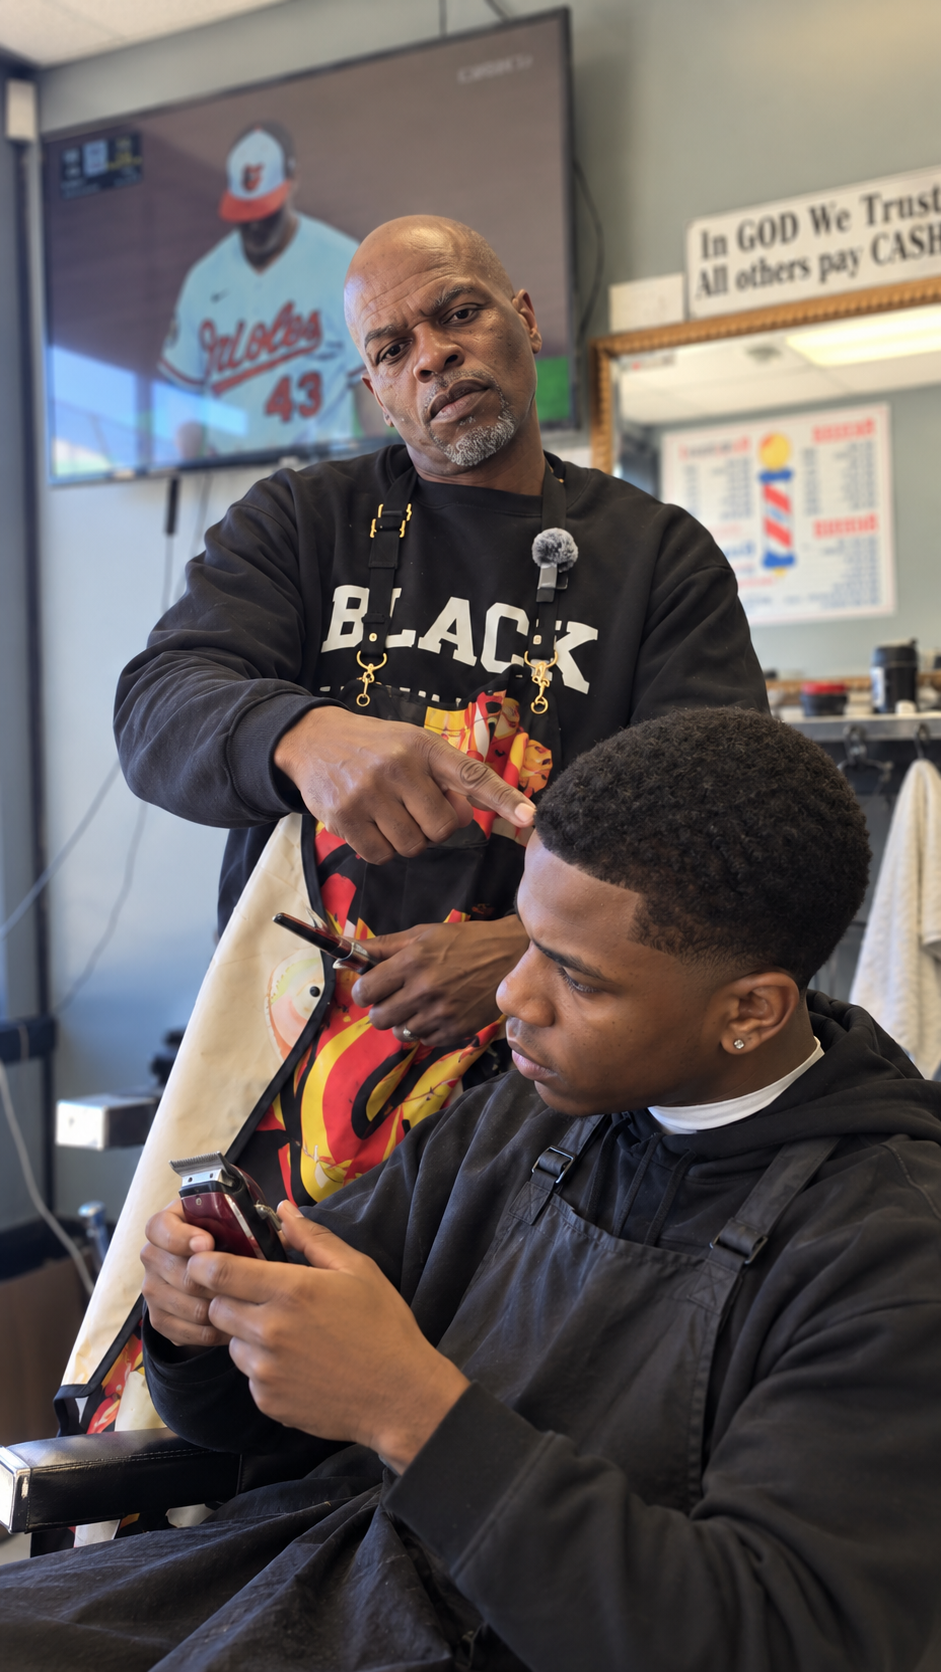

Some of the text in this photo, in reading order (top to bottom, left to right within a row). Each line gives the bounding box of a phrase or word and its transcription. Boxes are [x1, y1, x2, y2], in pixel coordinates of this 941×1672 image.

[697, 221, 941, 297] All others pay CASH
[701, 184, 941, 260] In GOD We Trust
[198, 300, 323, 381] Orioles
[263, 371, 323, 423] 43
